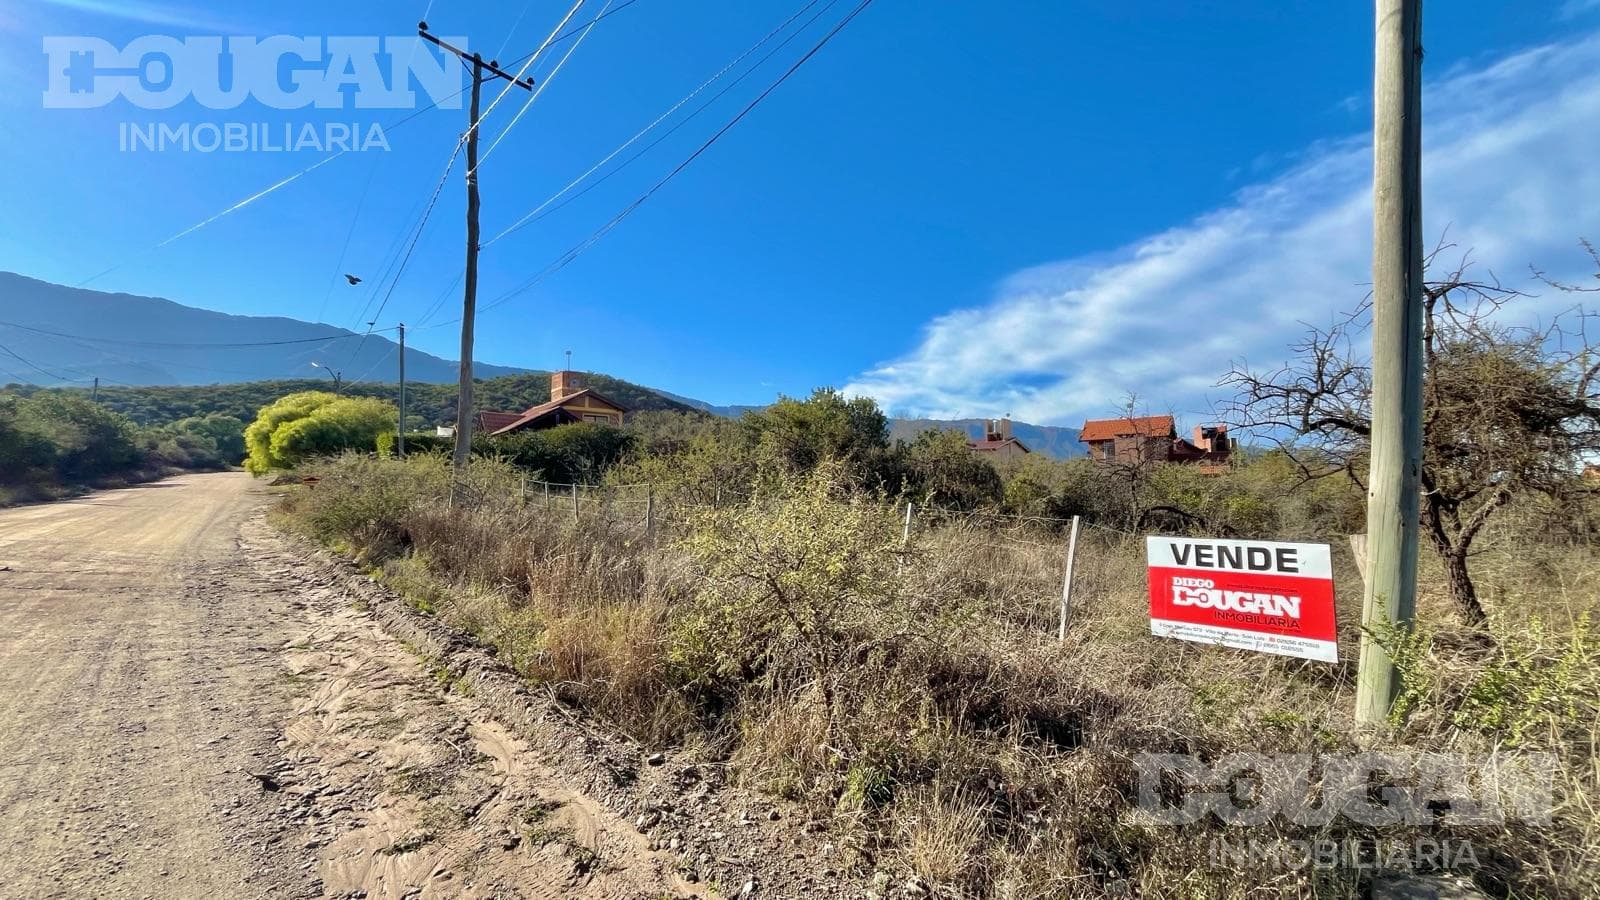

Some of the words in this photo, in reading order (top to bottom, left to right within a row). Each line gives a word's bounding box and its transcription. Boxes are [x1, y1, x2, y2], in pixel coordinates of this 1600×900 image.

[1170, 543, 1299, 573] VENDE
[1172, 577, 1214, 588] DIEGO
[1172, 586, 1302, 619] DOUGAN
[1214, 611, 1300, 628] INMOBILIARIA
